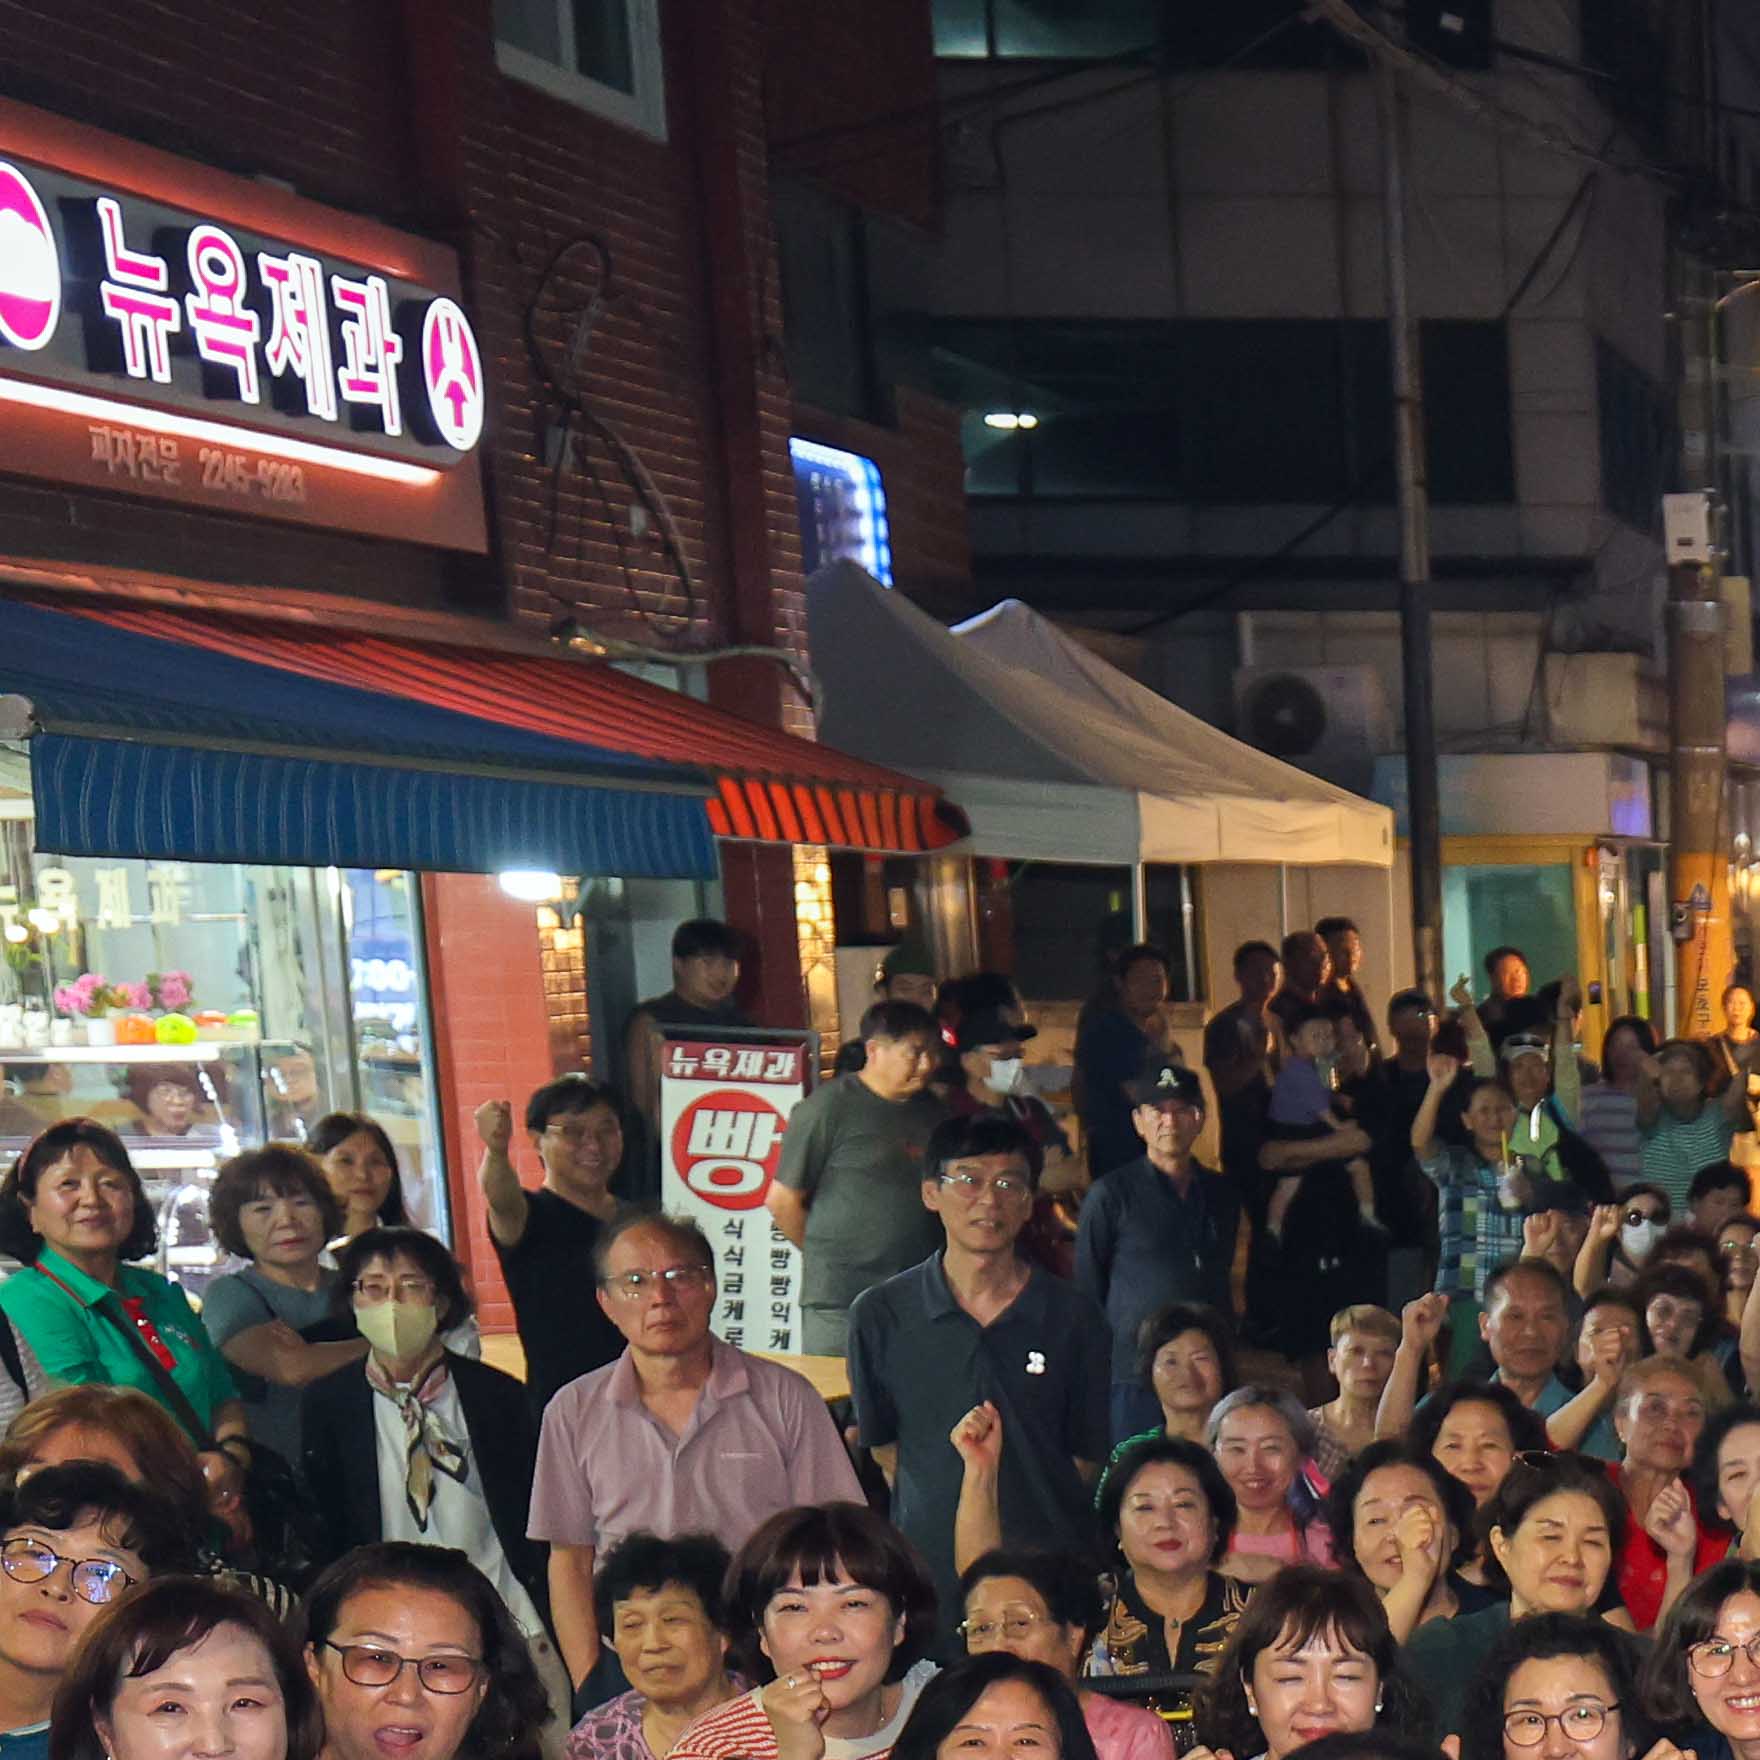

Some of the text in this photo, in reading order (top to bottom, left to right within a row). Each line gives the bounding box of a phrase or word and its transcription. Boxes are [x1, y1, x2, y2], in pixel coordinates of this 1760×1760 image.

[97, 197, 402, 436] 뉴욕제과
[669, 1046, 797, 1081] 뉴욕제과
[687, 1109, 783, 1195] 빵
